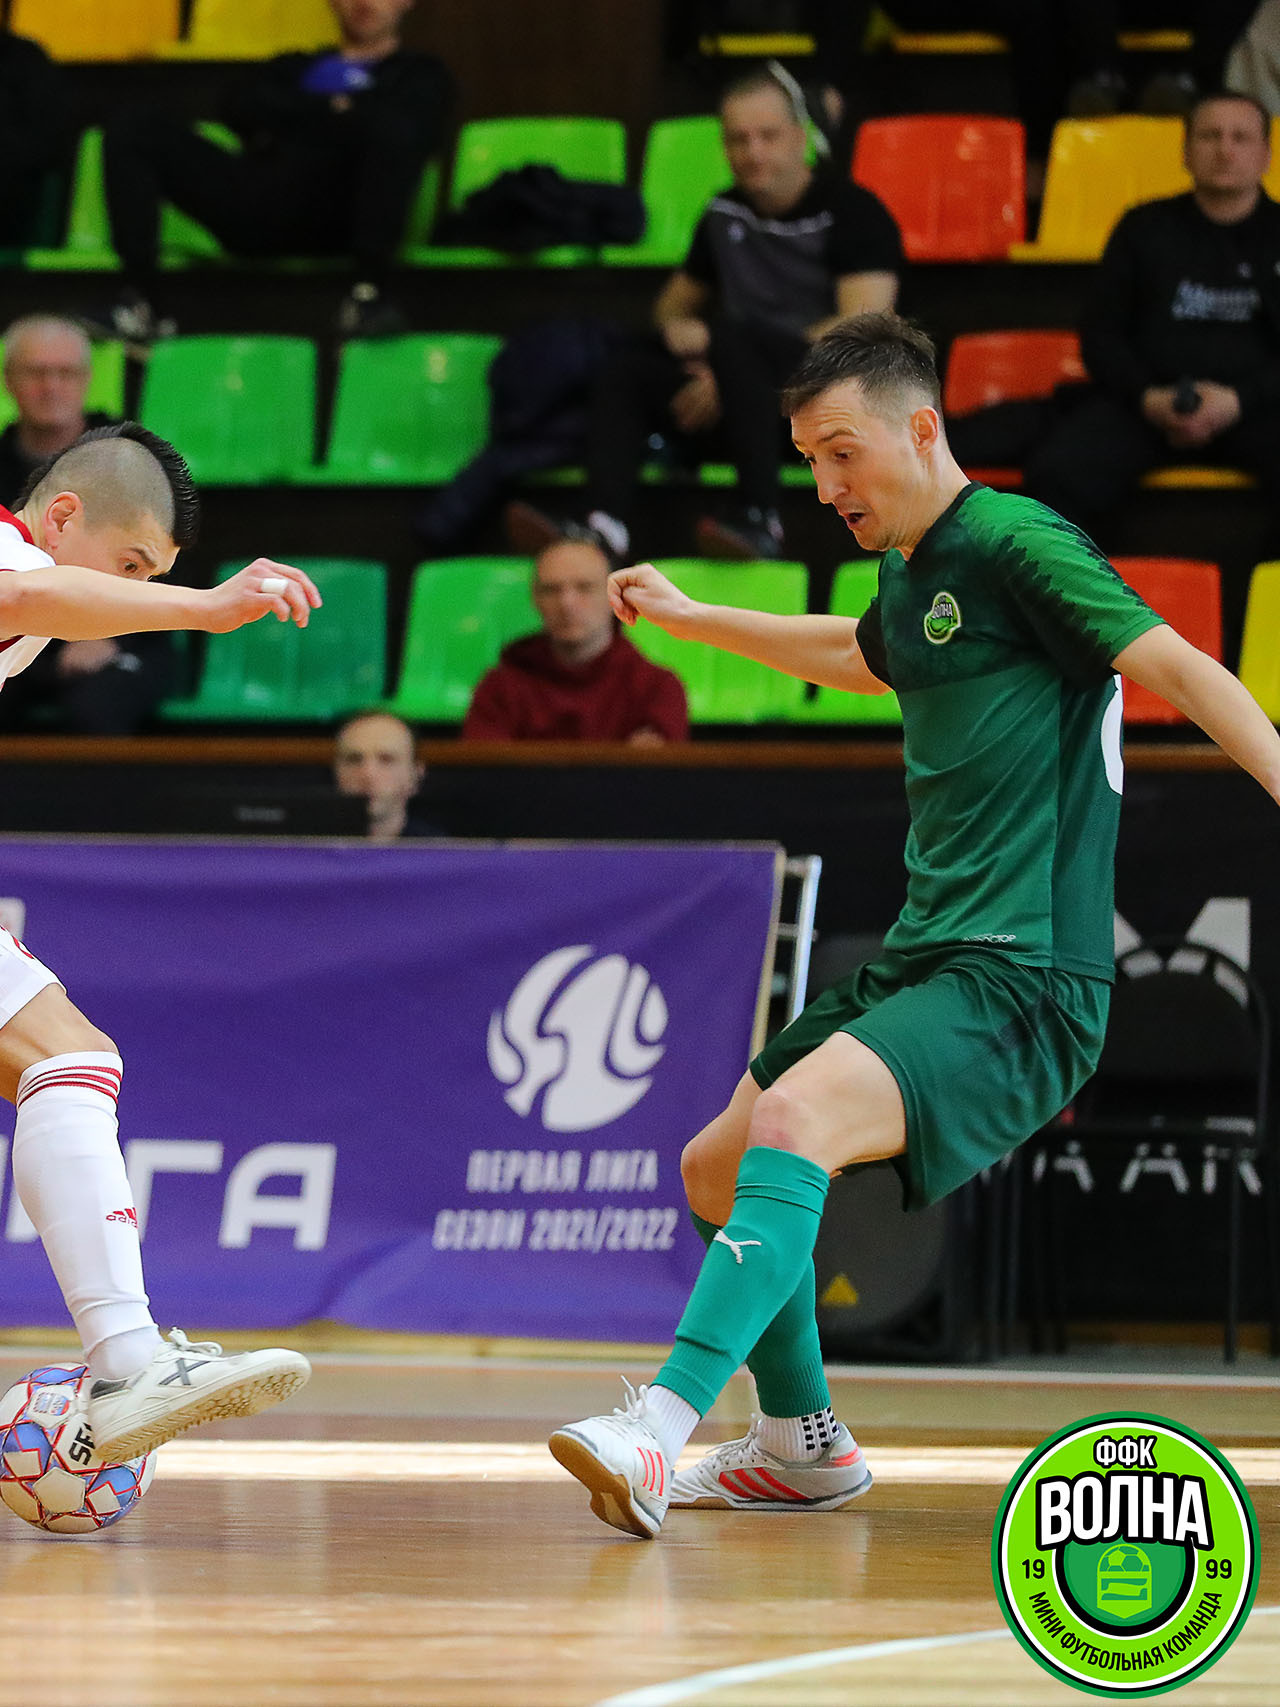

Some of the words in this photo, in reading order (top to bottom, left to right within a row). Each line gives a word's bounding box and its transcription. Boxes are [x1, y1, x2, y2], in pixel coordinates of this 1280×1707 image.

[466, 1149, 582, 1193] ПЕРВАЯ
[585, 1149, 659, 1193] ЛИГА
[431, 1209, 527, 1251] СЕЗОН
[528, 1206, 679, 1254] 2021/2022
